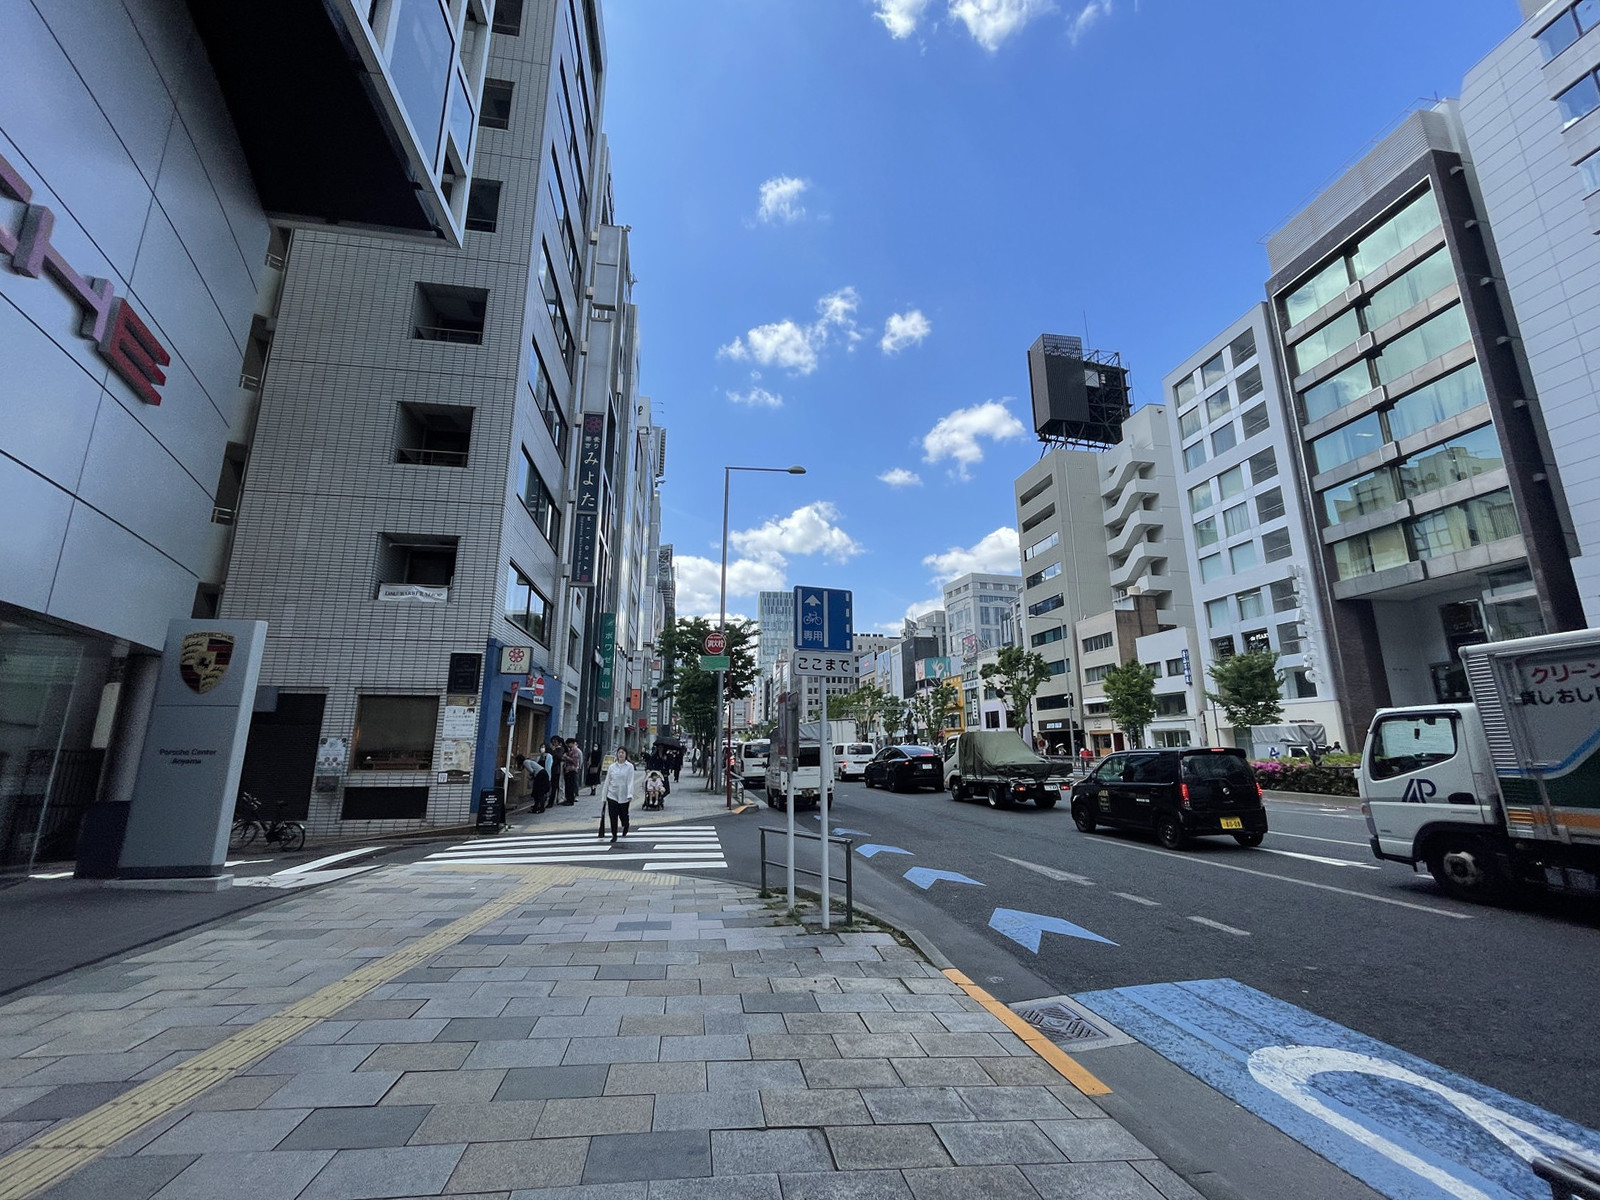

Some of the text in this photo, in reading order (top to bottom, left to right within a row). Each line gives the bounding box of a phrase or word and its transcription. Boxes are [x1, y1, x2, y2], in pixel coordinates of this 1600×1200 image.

[581, 452, 599, 507] みよた
[583, 516, 591, 571] MIYOTA
[185, 632, 235, 641] PORSCHE
[803, 630, 823, 642] 専用
[798, 657, 850, 672] ここまで
[1519, 686, 1600, 706] 貸しおし
